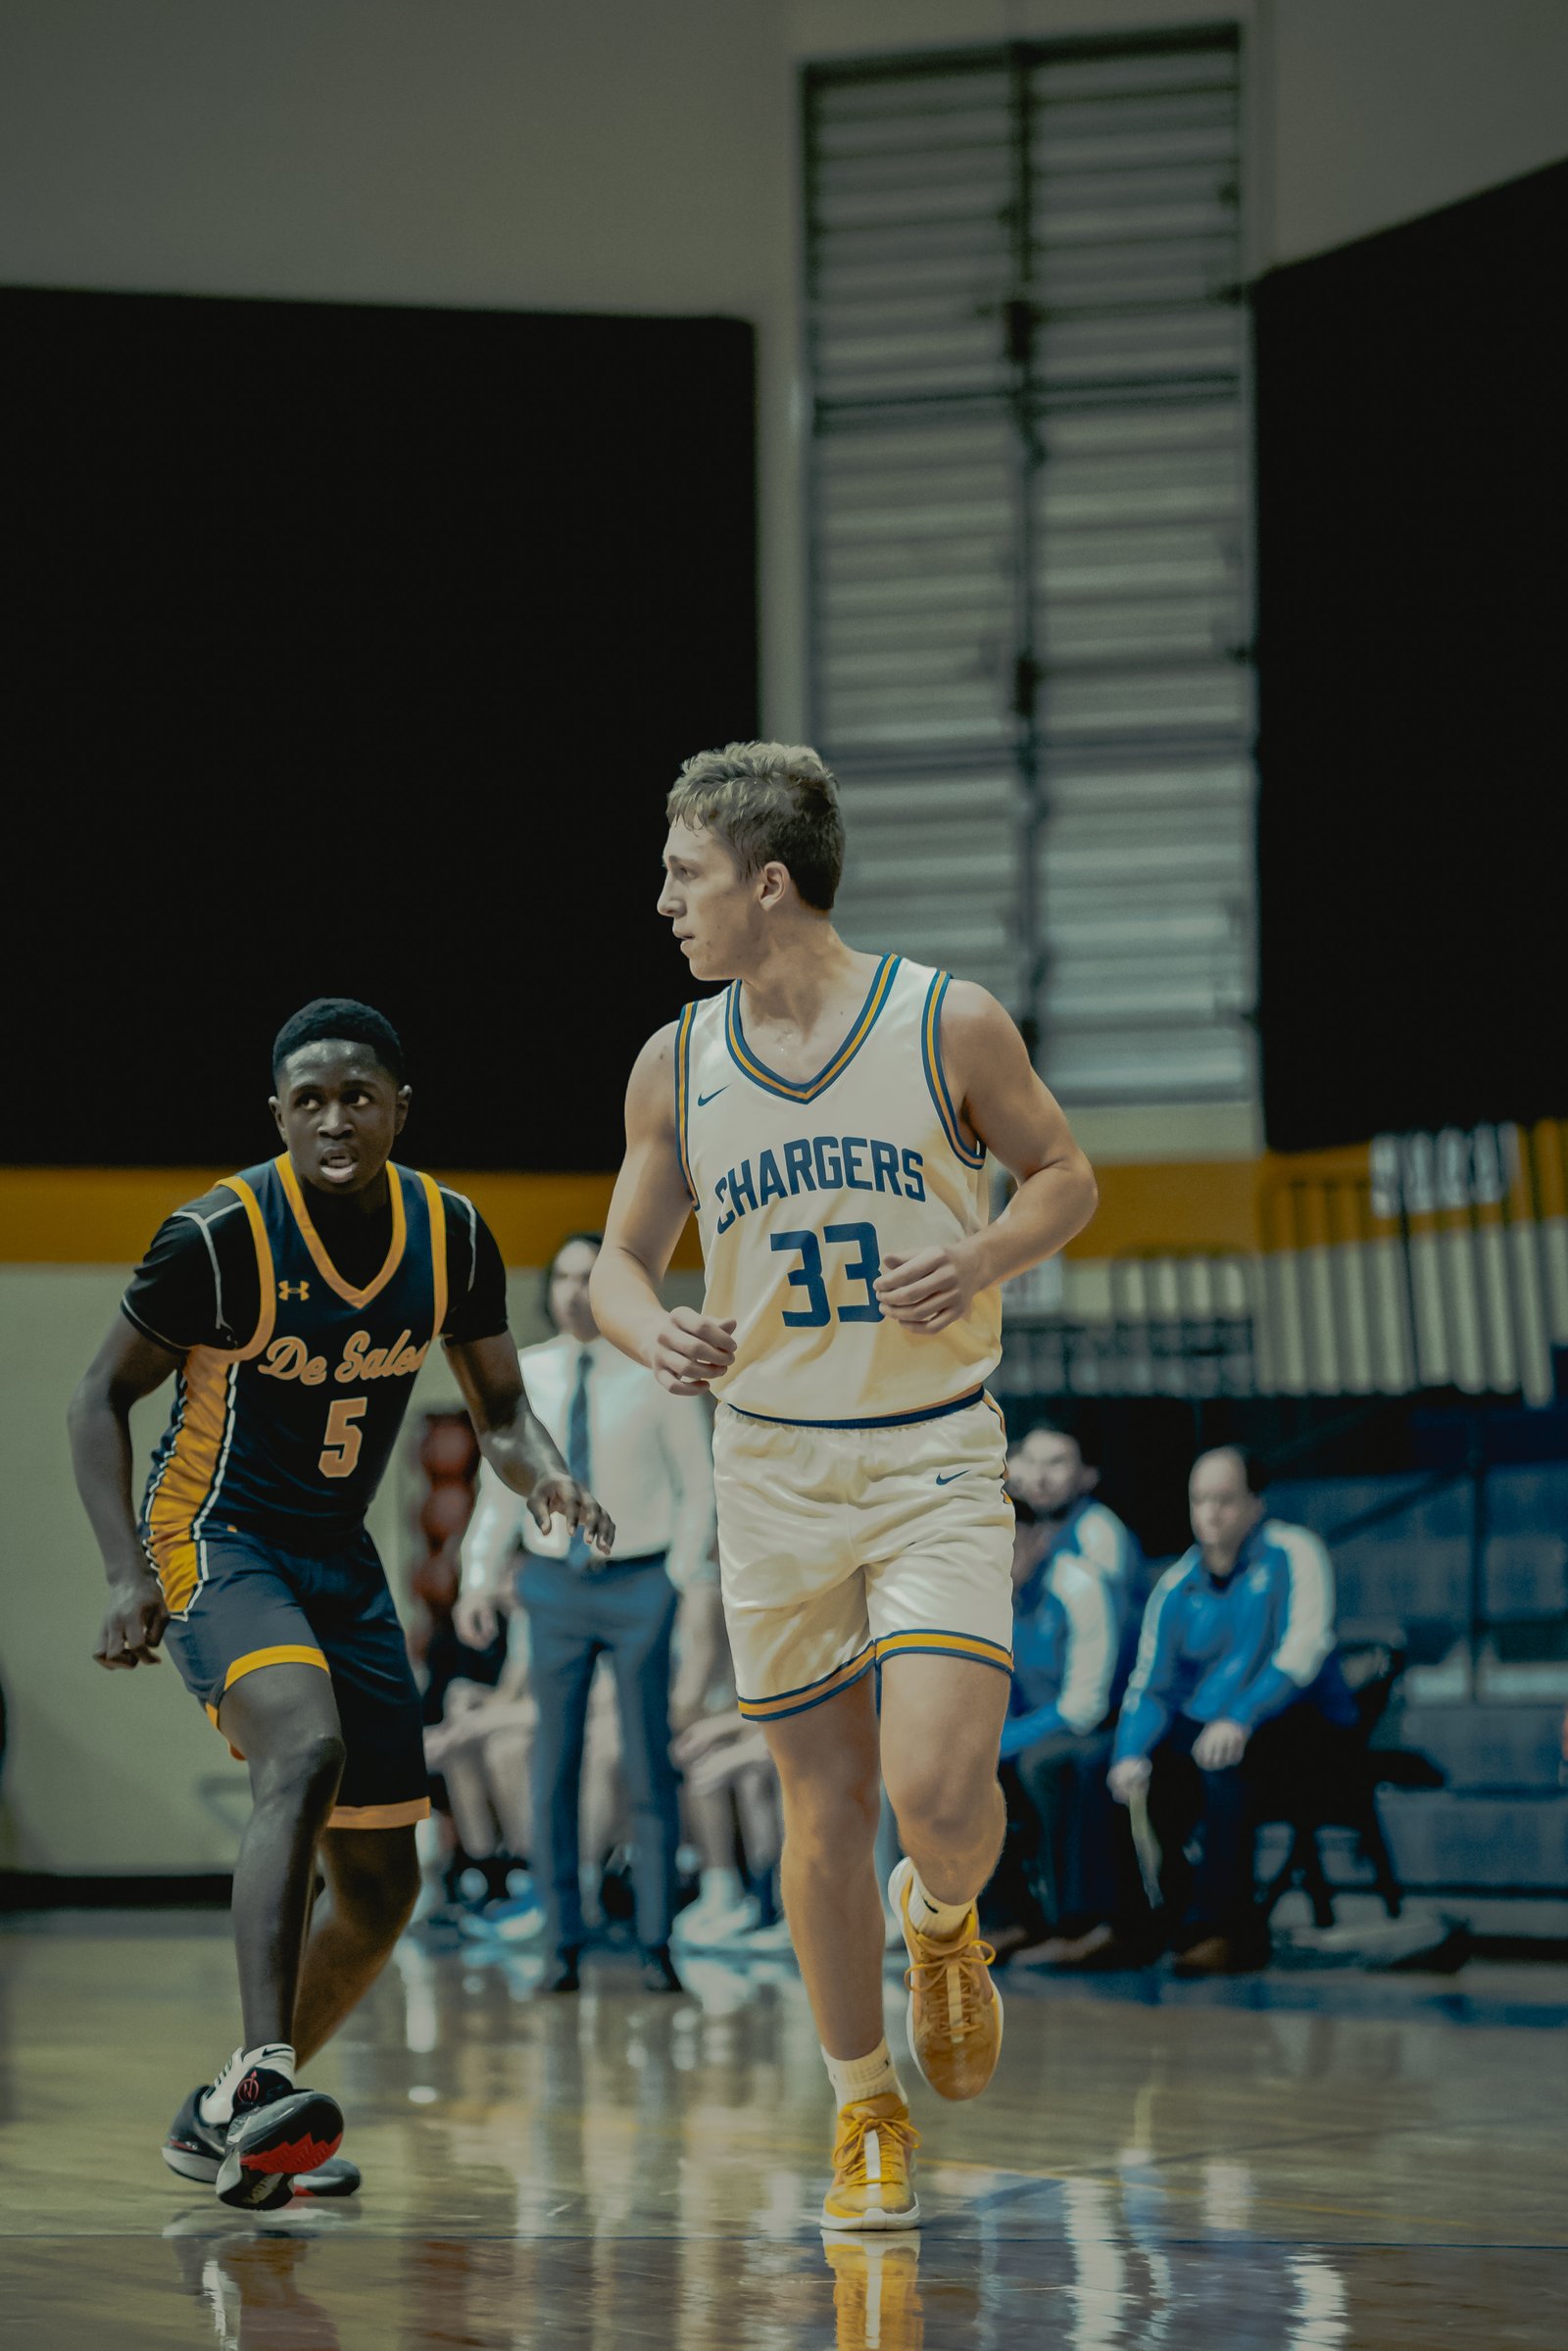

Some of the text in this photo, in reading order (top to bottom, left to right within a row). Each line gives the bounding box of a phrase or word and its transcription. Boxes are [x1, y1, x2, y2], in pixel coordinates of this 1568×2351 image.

[714, 1136, 926, 1235] CHARGERS
[770, 1222, 885, 1327] 33
[258, 1336, 327, 1386] De
[318, 1396, 368, 1477] 5
